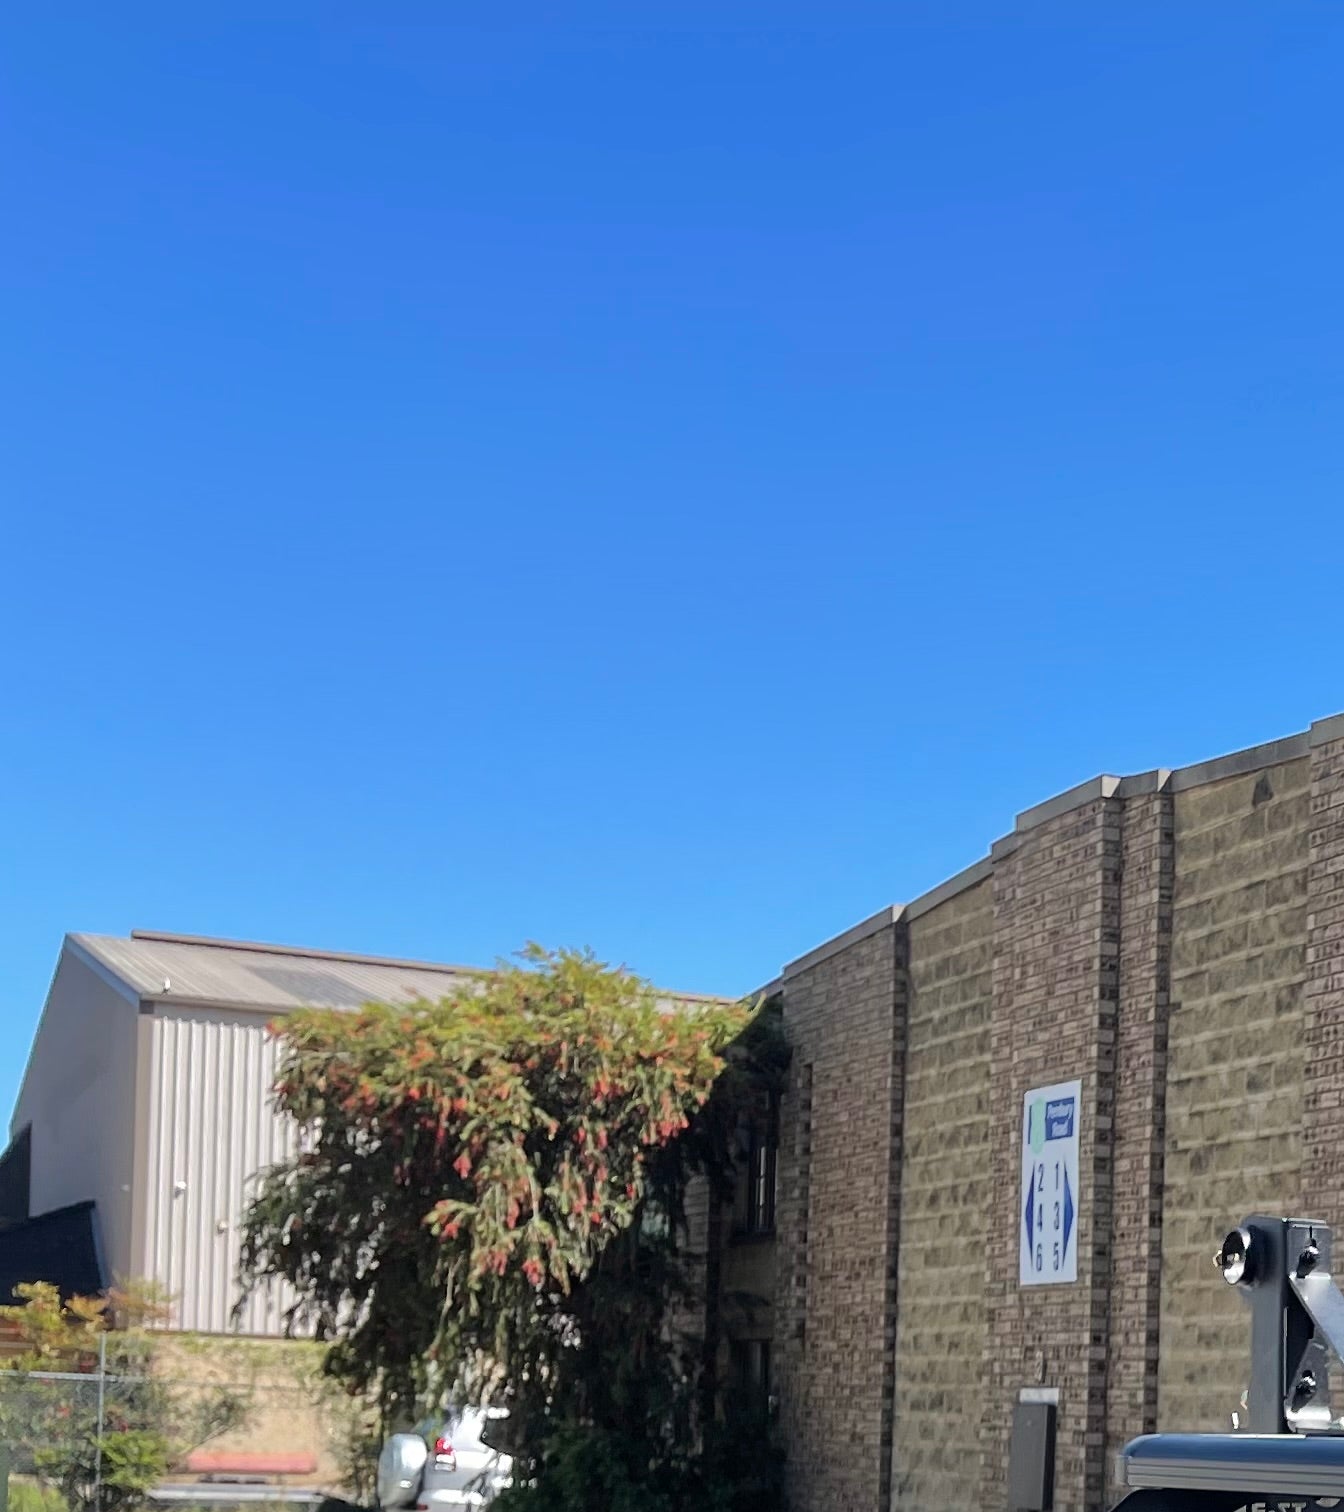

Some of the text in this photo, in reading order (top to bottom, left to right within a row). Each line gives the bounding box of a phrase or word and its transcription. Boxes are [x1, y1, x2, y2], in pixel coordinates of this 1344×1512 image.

[1037, 1163, 1045, 1193] 2
[1037, 1201, 1060, 1233] 4 3
[1036, 1241, 1060, 1273] 6 5
